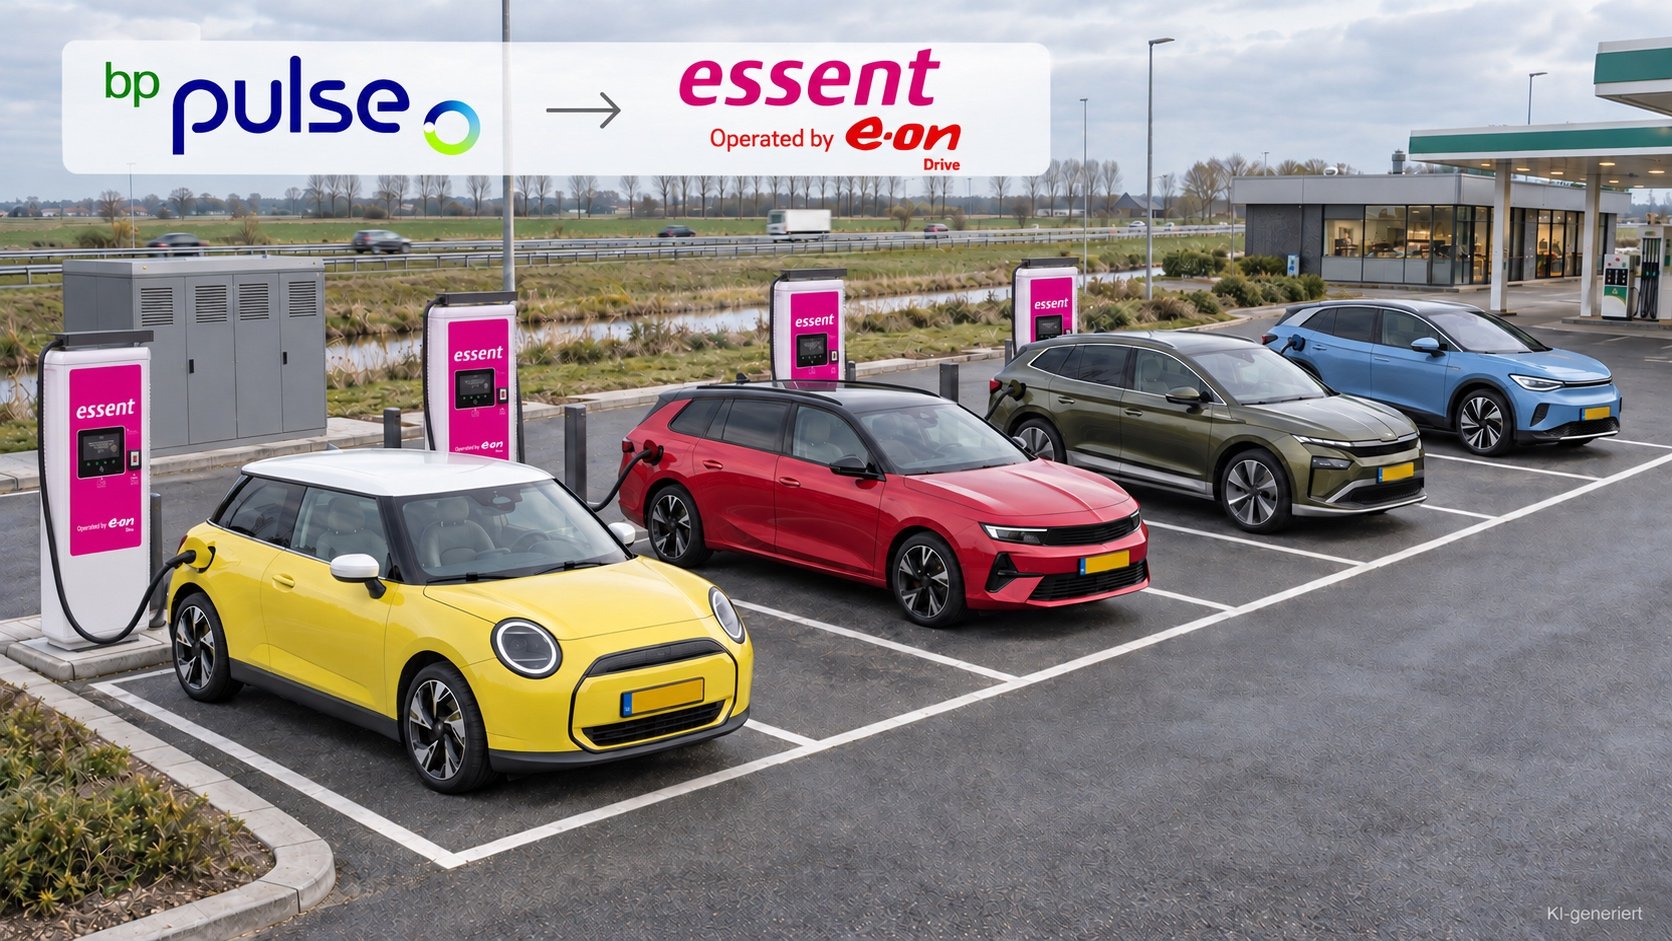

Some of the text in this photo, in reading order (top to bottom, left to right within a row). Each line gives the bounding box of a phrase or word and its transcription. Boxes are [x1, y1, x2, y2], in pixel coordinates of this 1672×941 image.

[1034, 297, 1069, 310] essent
[795, 313, 835, 328] essent
[453, 345, 504, 362] essent
[76, 398, 136, 420] essent
